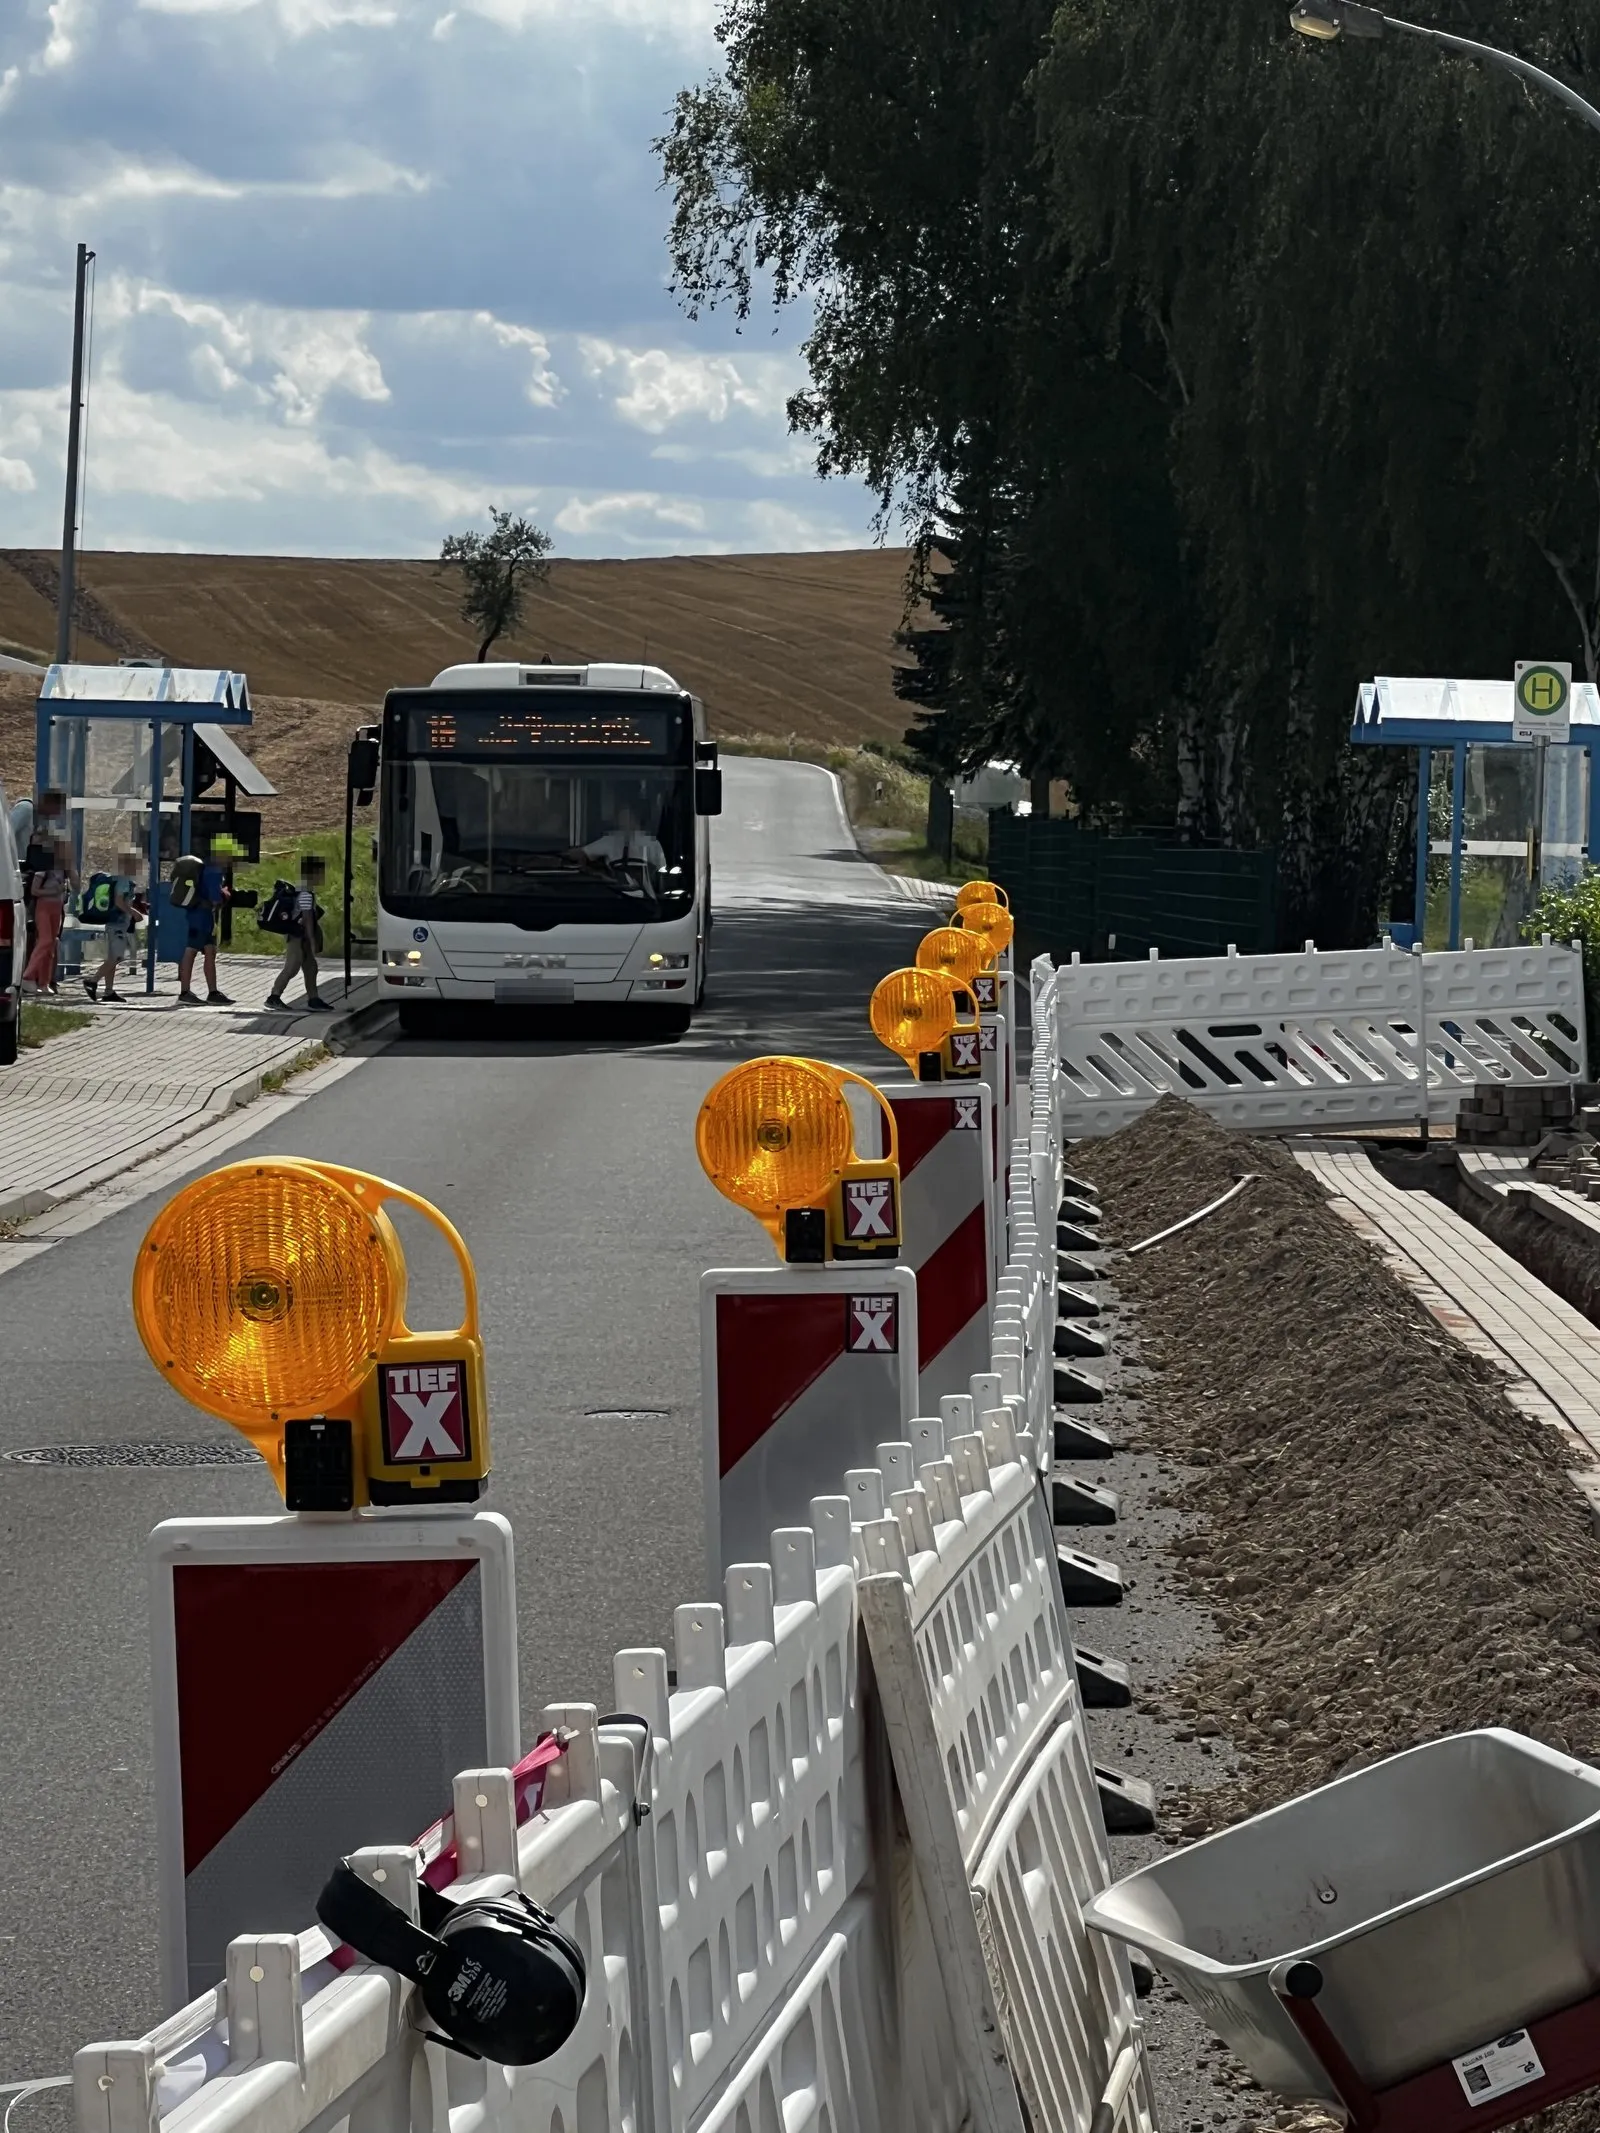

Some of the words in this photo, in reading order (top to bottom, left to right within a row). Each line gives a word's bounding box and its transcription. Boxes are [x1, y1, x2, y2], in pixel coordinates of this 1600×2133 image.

[1531, 677, 1553, 704] H
[978, 985, 993, 1001] X
[953, 1035, 976, 1045] TIEF
[955, 1043, 978, 1066] X
[955, 1106, 978, 1129] X
[848, 1181, 889, 1198] TIEF
[850, 1196, 892, 1236] X
[852, 1297, 893, 1312] TIEF
[853, 1311, 892, 1350] X
[388, 1366, 458, 1393] TIEF
[391, 1391, 461, 1458] X
[448, 1973, 471, 2001] 3M
